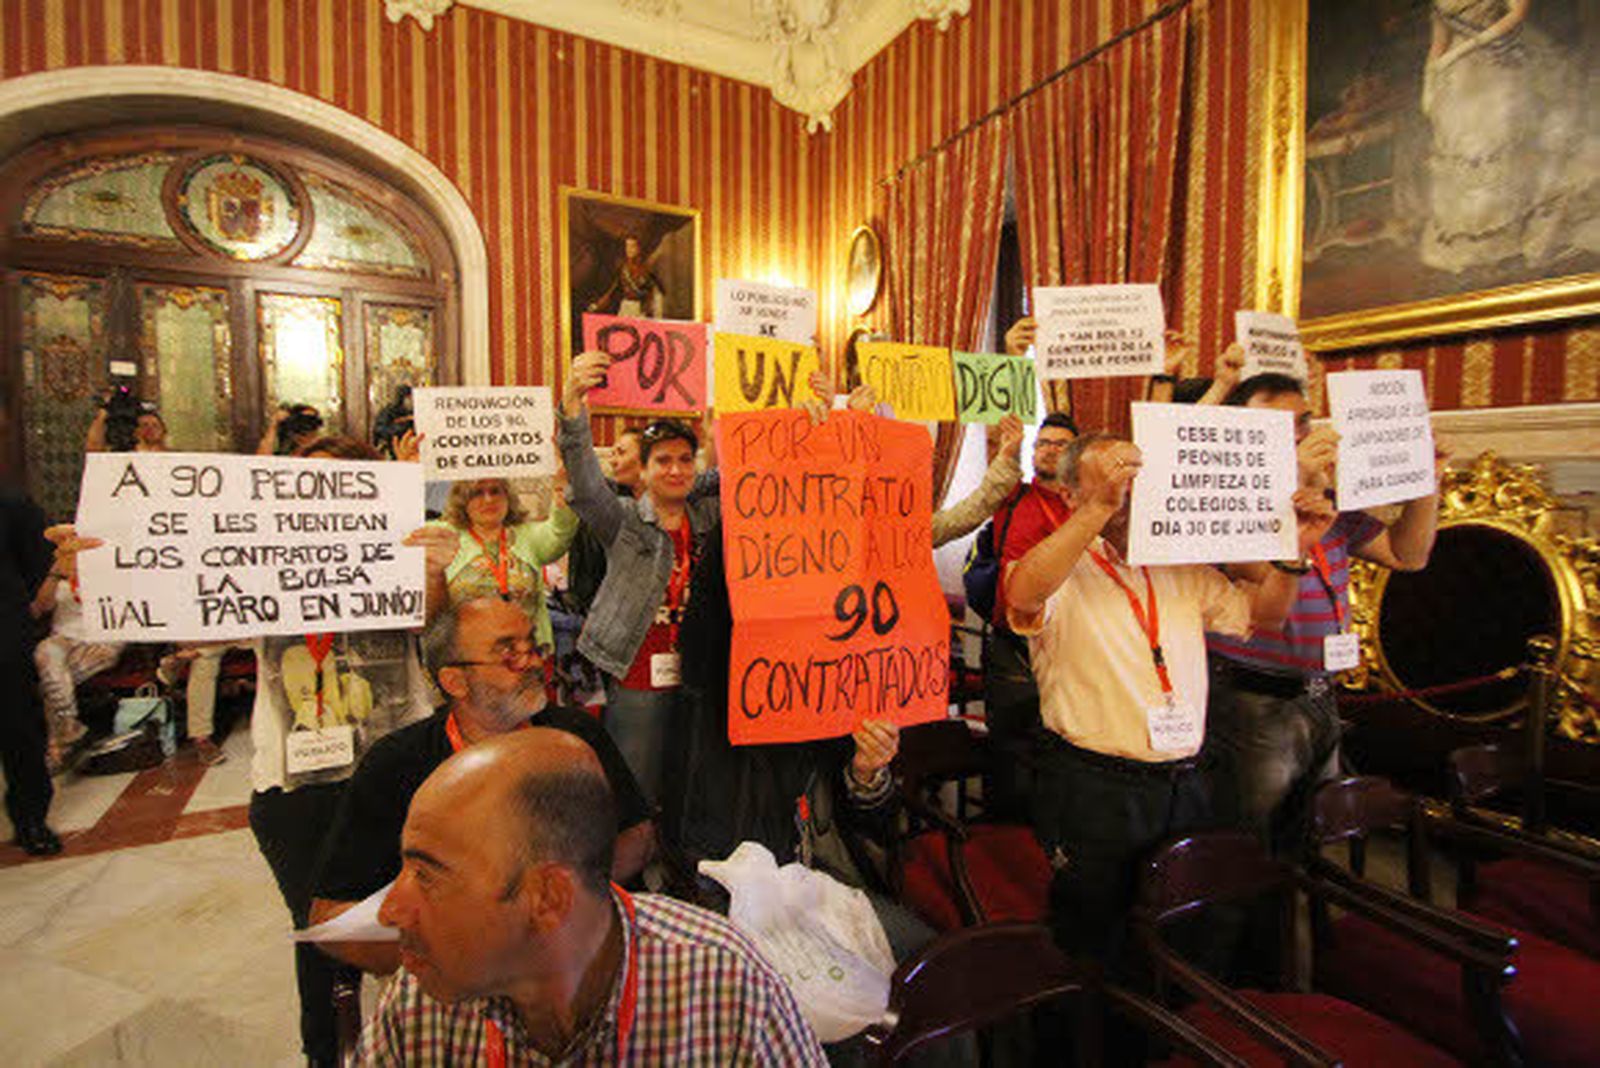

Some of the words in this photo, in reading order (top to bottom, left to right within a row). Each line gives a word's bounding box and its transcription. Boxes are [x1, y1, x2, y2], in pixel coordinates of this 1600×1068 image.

[1047, 342, 1117, 355] CONTRATOS
[1139, 340, 1154, 350] LA
[595, 323, 697, 406] POR
[1047, 357, 1085, 369] BOLSA
[1107, 353, 1153, 365] PEONES
[738, 349, 800, 407] UN
[434, 394, 535, 410] RENOVACIÓN
[446, 415, 467, 428] DE
[471, 414, 502, 428] LOS
[731, 415, 813, 466] POR
[835, 417, 881, 464] UN
[1176, 426, 1219, 443] CESE
[1224, 428, 1243, 445] DE
[1247, 429, 1267, 446] 90
[436, 455, 458, 469] DE
[1176, 449, 1243, 466] PEONES
[1246, 451, 1266, 467] DE
[110, 461, 150, 498] A
[170, 464, 224, 498] 90
[250, 468, 381, 500] PEONES
[1171, 473, 1248, 490] LIMPIEZA
[1251, 474, 1272, 490] DE
[735, 471, 915, 519] CONTRATO
[1256, 496, 1275, 512] EL
[148, 512, 190, 536] SE
[213, 512, 259, 534] LES
[274, 512, 389, 534] PUENTEAN
[1186, 520, 1206, 536] 30
[1210, 519, 1231, 535] DE
[1235, 518, 1282, 535] JUNIO
[114, 545, 184, 570] LOS
[199, 544, 350, 568] CONTRATOS
[360, 542, 395, 562] DE
[864, 529, 881, 571] A
[197, 573, 245, 597] LA
[277, 564, 373, 593] BOLSA
[195, 594, 280, 627] PARO
[299, 592, 342, 622] EN
[824, 580, 900, 642] 90
[740, 640, 949, 720] CONTRATADOS
